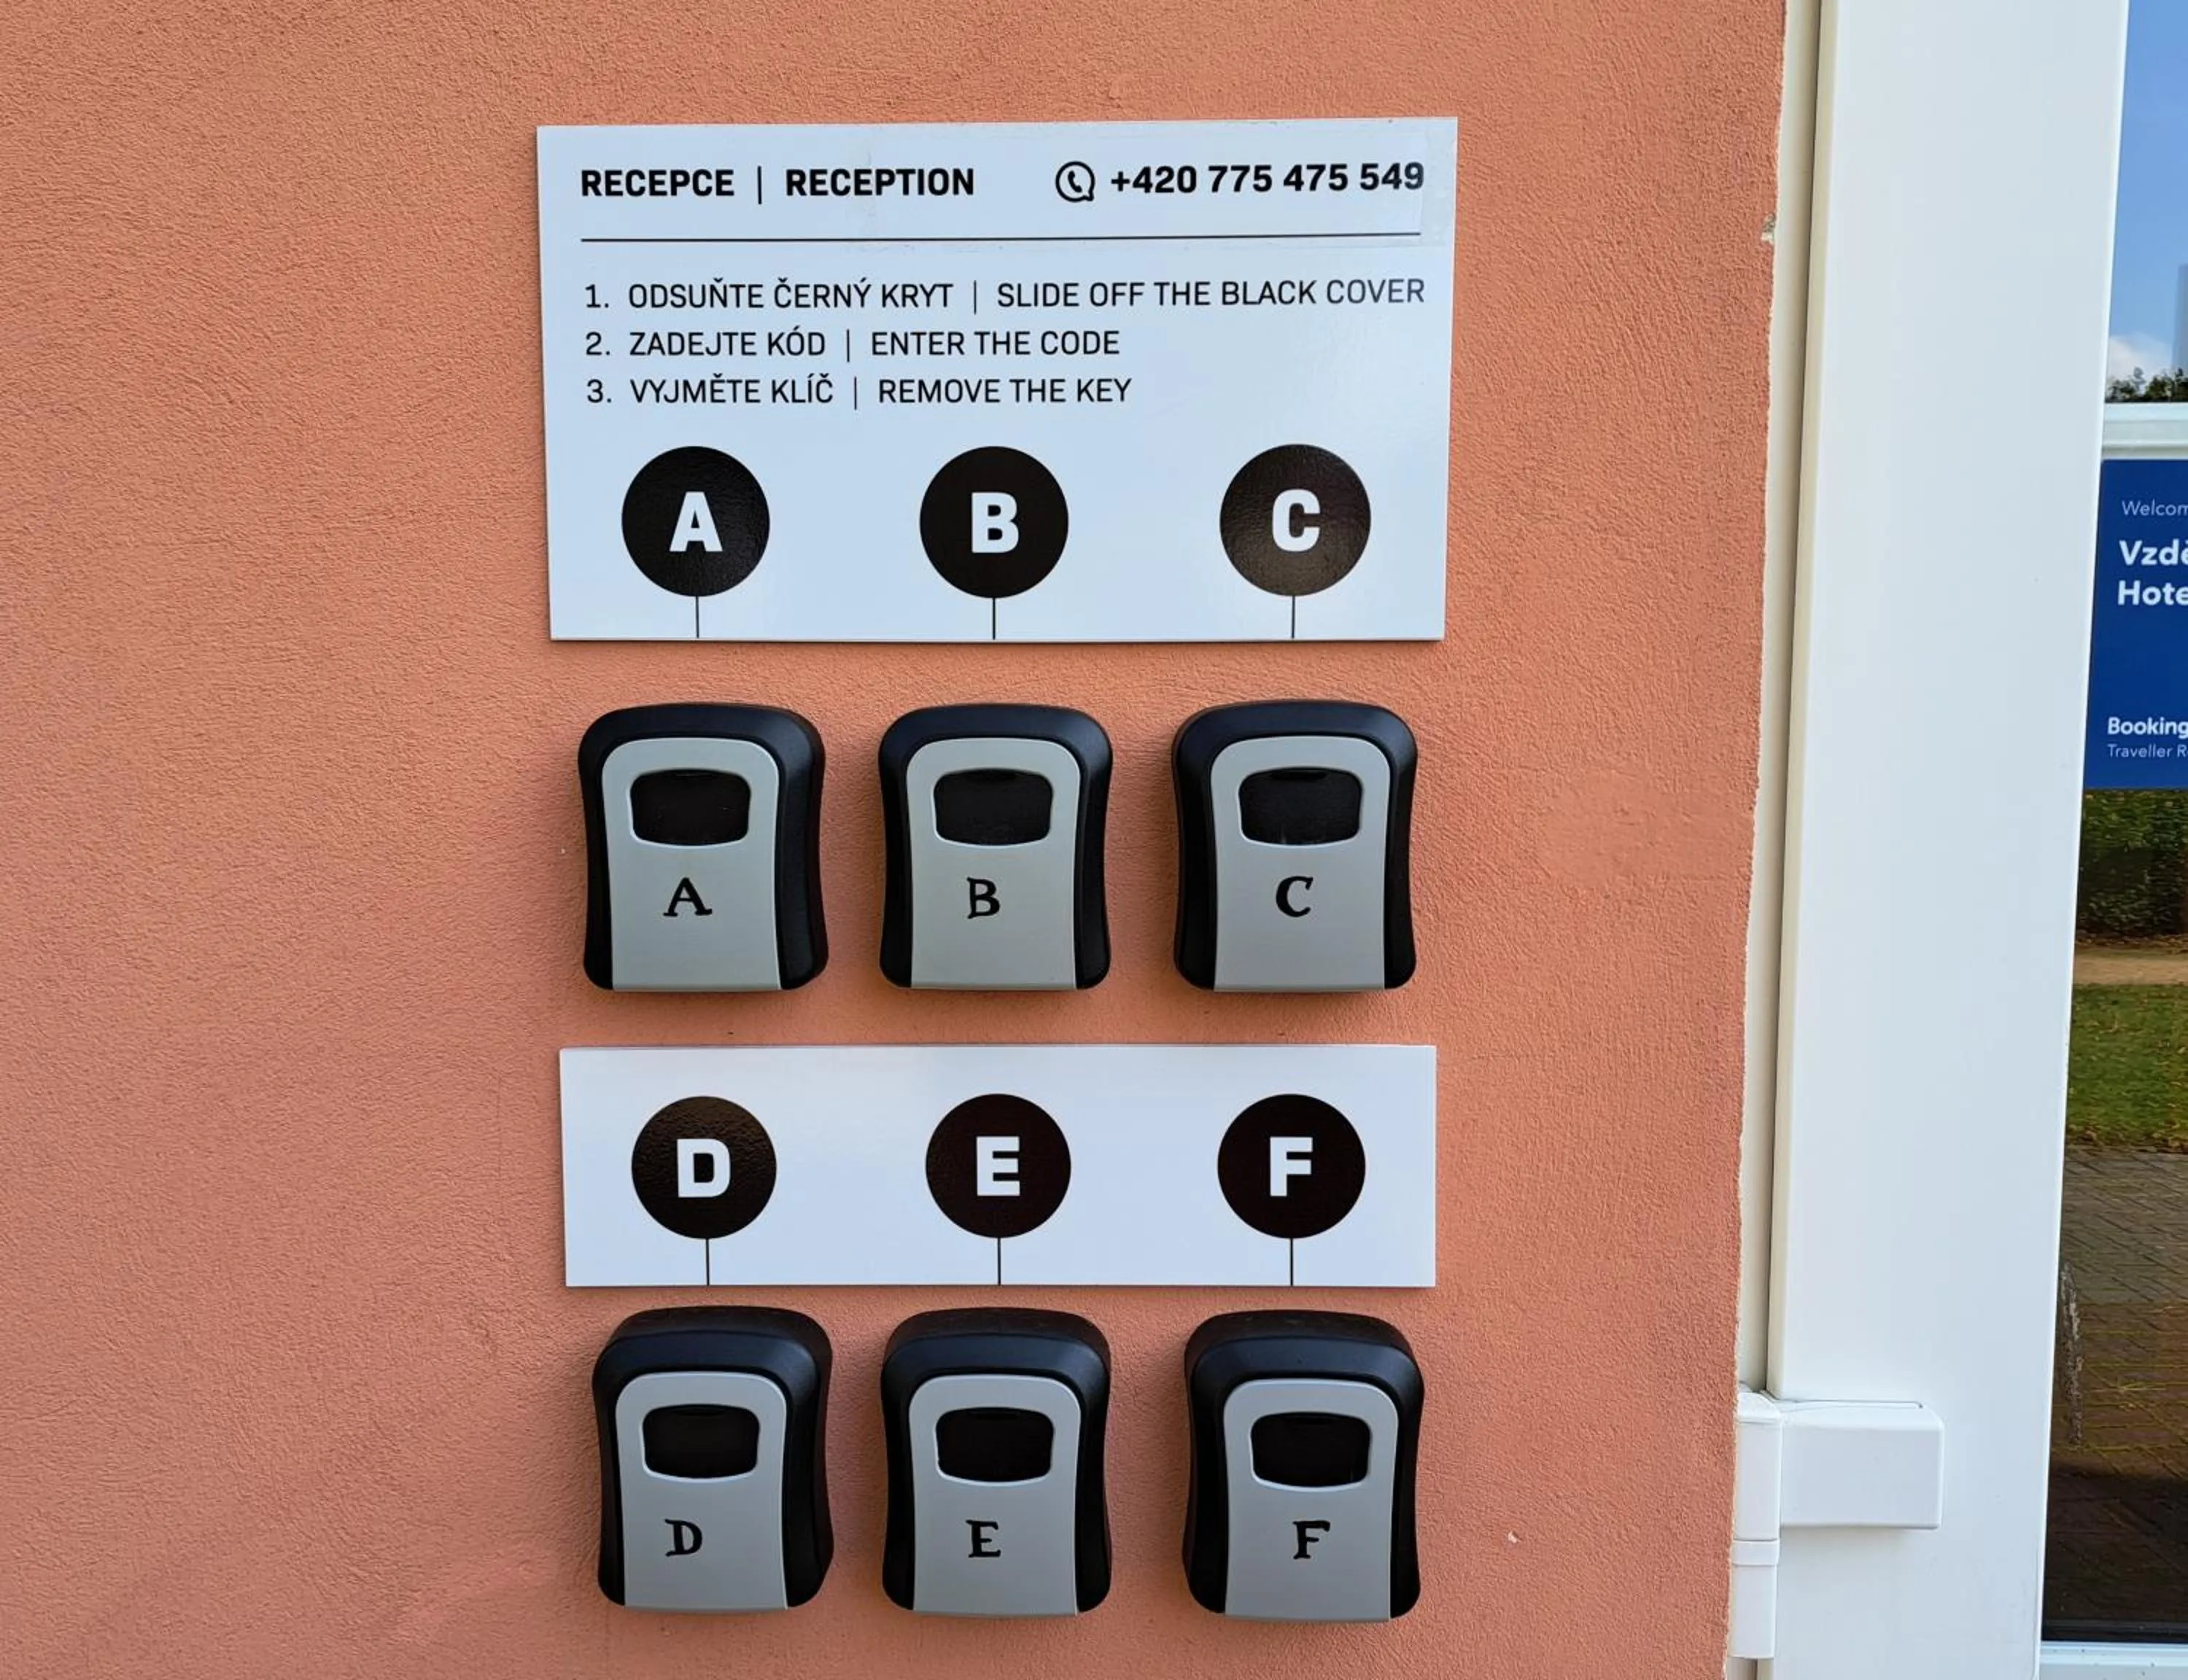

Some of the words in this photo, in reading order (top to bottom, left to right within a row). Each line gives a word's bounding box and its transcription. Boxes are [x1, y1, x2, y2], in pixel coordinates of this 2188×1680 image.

[582, 169, 734, 197] RECEPCE
[786, 168, 974, 196] RECEPTION
[1111, 165, 1197, 193] +420
[1208, 164, 1273, 192] 775
[1283, 163, 1349, 192] 475
[1359, 162, 1424, 190] 549
[585, 284, 609, 308] 1.
[629, 278, 764, 308] ODSUŇTE
[774, 277, 872, 308] ČERNÝ
[882, 283, 954, 308] KRYT
[997, 282, 1079, 308] SLIDE
[1090, 281, 1145, 307] OFF
[1153, 281, 1211, 306] THE
[1222, 280, 1316, 306] BLACK
[1327, 279, 1424, 304] COVER
[586, 331, 610, 356] 2.
[629, 332, 757, 357] ZADEJTE
[767, 325, 826, 357] KÓD
[872, 331, 965, 356] ENTER
[974, 330, 1031, 355] THE
[1041, 330, 1120, 355] CODE
[586, 378, 612, 403] 3.
[629, 373, 761, 404] VYJMĚTE
[771, 373, 834, 403] KLÍČ
[879, 378, 1001, 403] REMOVE
[1009, 378, 1066, 403] THE
[1076, 378, 1132, 402] KEY
[670, 491, 723, 552] A
[971, 492, 1019, 553] B
[1272, 489, 1320, 552] C
[2107, 743, 2173, 758] Traveller
[663, 877, 713, 917] A
[966, 876, 1001, 919] B
[1276, 876, 1314, 918] C
[677, 1138, 731, 1198] D
[976, 1136, 1020, 1197] E
[1270, 1137, 1313, 1197] F
[664, 1518, 703, 1558] D
[966, 1519, 1001, 1558] E
[1292, 1520, 1331, 1560] F
